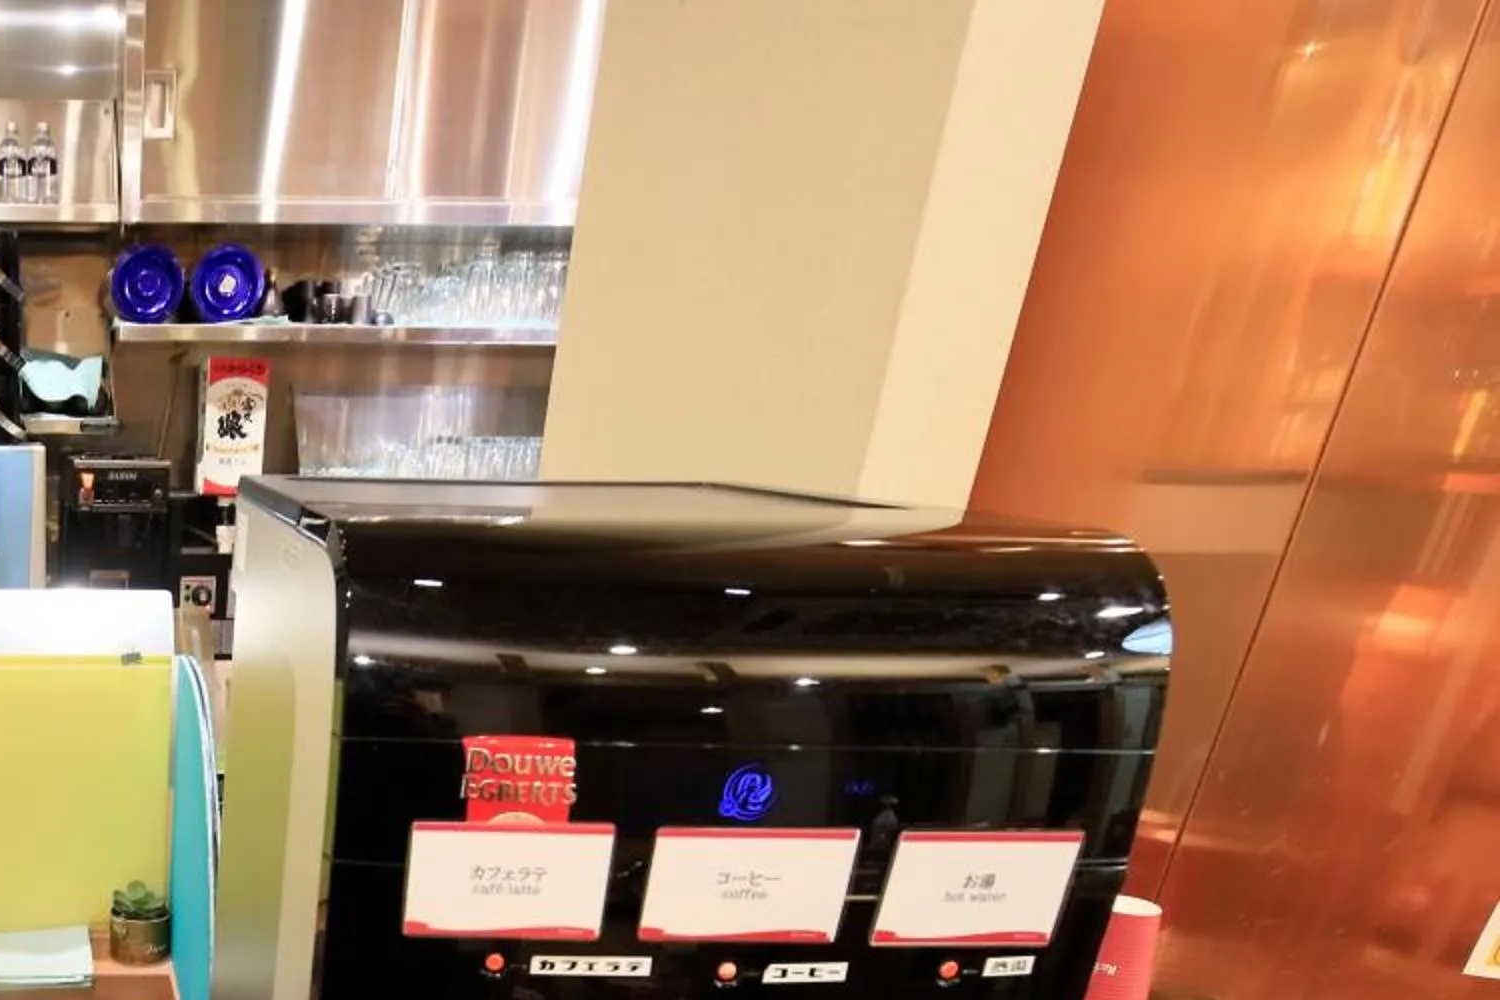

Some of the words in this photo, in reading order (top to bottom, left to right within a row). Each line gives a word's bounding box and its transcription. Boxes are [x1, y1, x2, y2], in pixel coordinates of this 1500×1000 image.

[466, 747, 577, 778] Douwe
[470, 865, 548, 882] カフェラテ
[716, 870, 782, 887] コーヒー
[963, 872, 997, 889] お湯
[721, 888, 768, 901] coffee
[538, 959, 643, 973] カフェラテ
[771, 966, 841, 979] コーヒー
